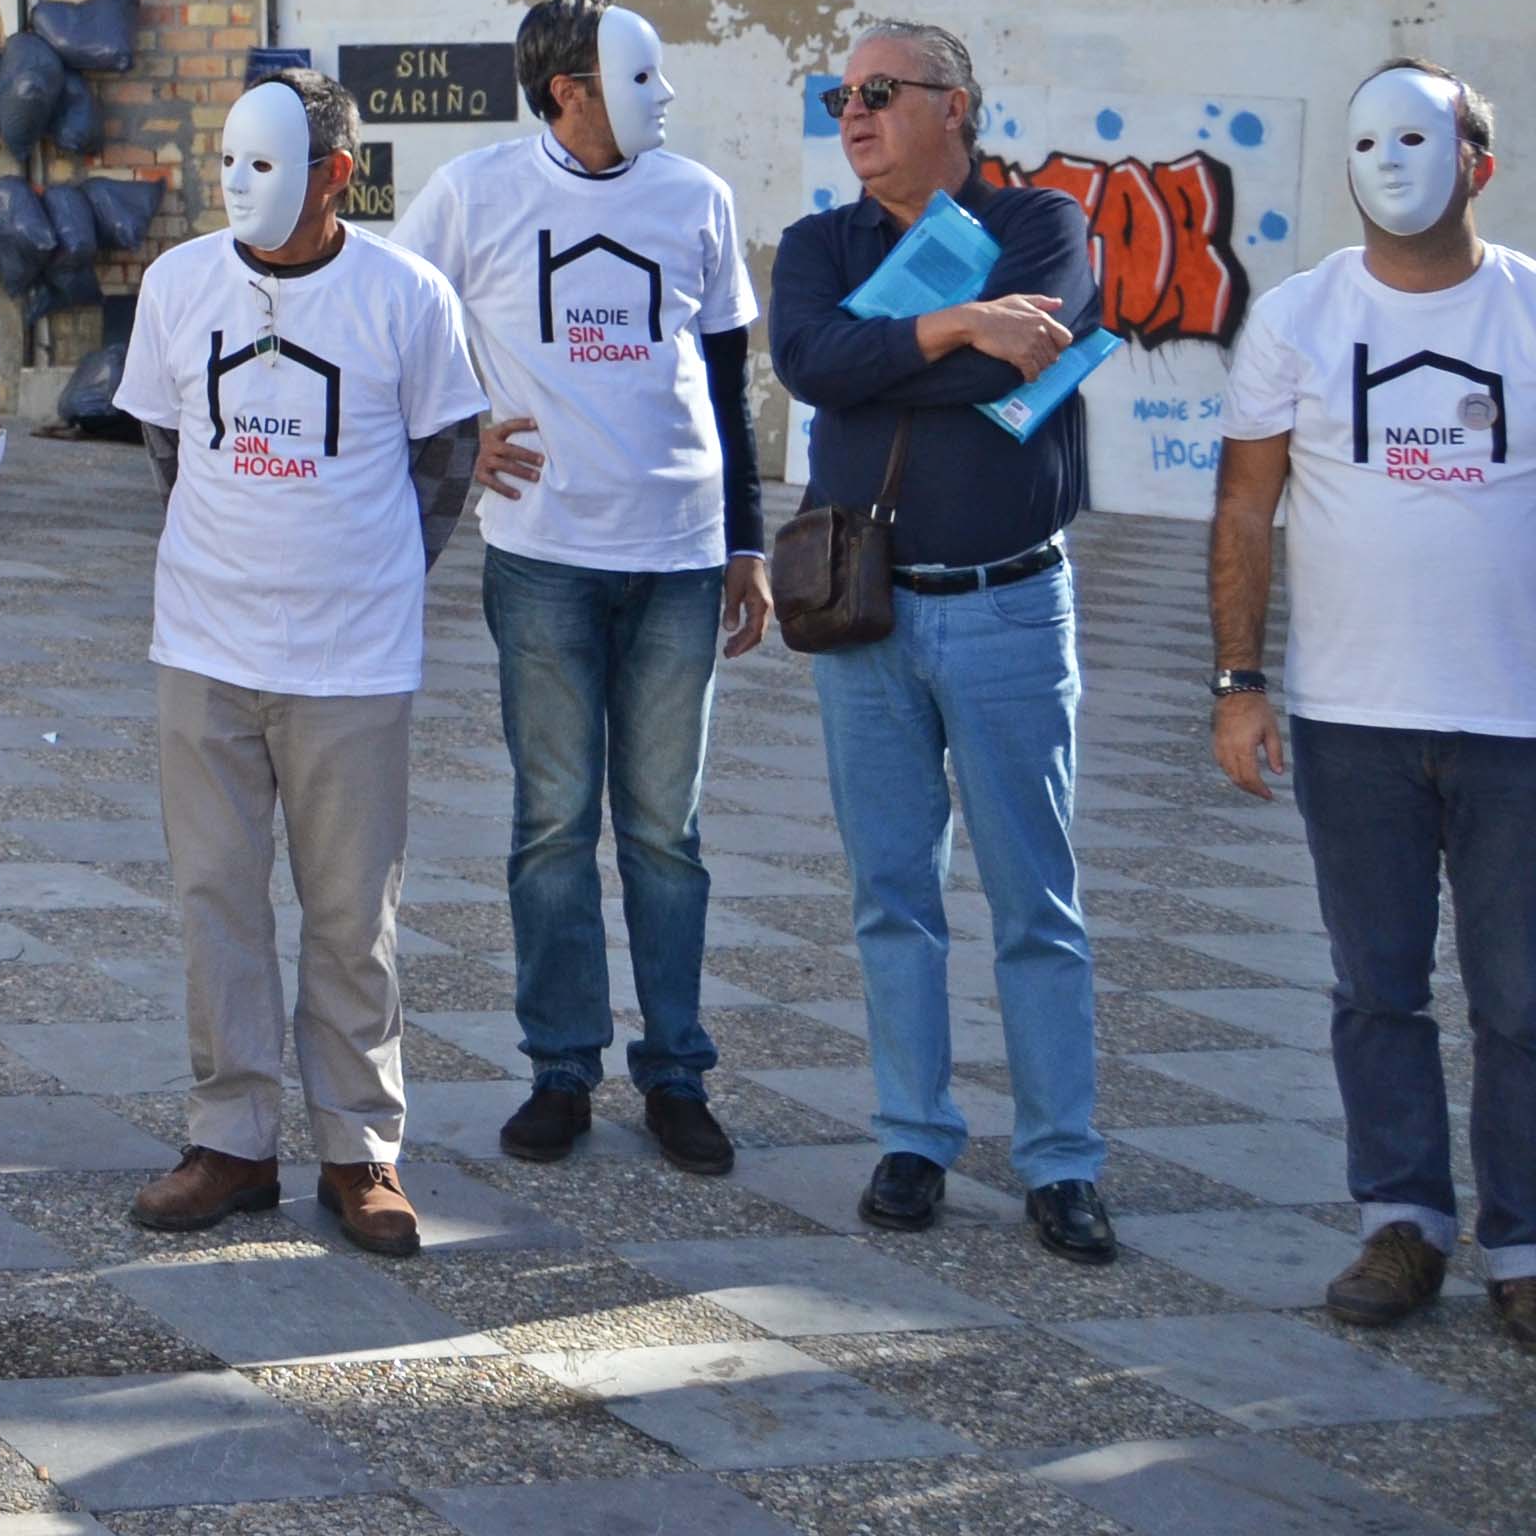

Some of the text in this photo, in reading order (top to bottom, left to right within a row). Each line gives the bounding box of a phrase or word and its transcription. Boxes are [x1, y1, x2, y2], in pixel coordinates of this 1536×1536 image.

[396, 49, 449, 79] SIN
[369, 83, 489, 117] CARIÑO
[566, 308, 629, 325] NADIE
[568, 326, 604, 344] SIN
[569, 344, 650, 362] HOGAR
[233, 416, 302, 437] NADIE
[1385, 427, 1465, 445] NADIE
[233, 436, 269, 455] SIN
[1151, 435, 1221, 472] HOGA
[1386, 447, 1430, 465] SIN
[233, 455, 317, 478] HOGAR
[1387, 467, 1486, 484] HOGAR
